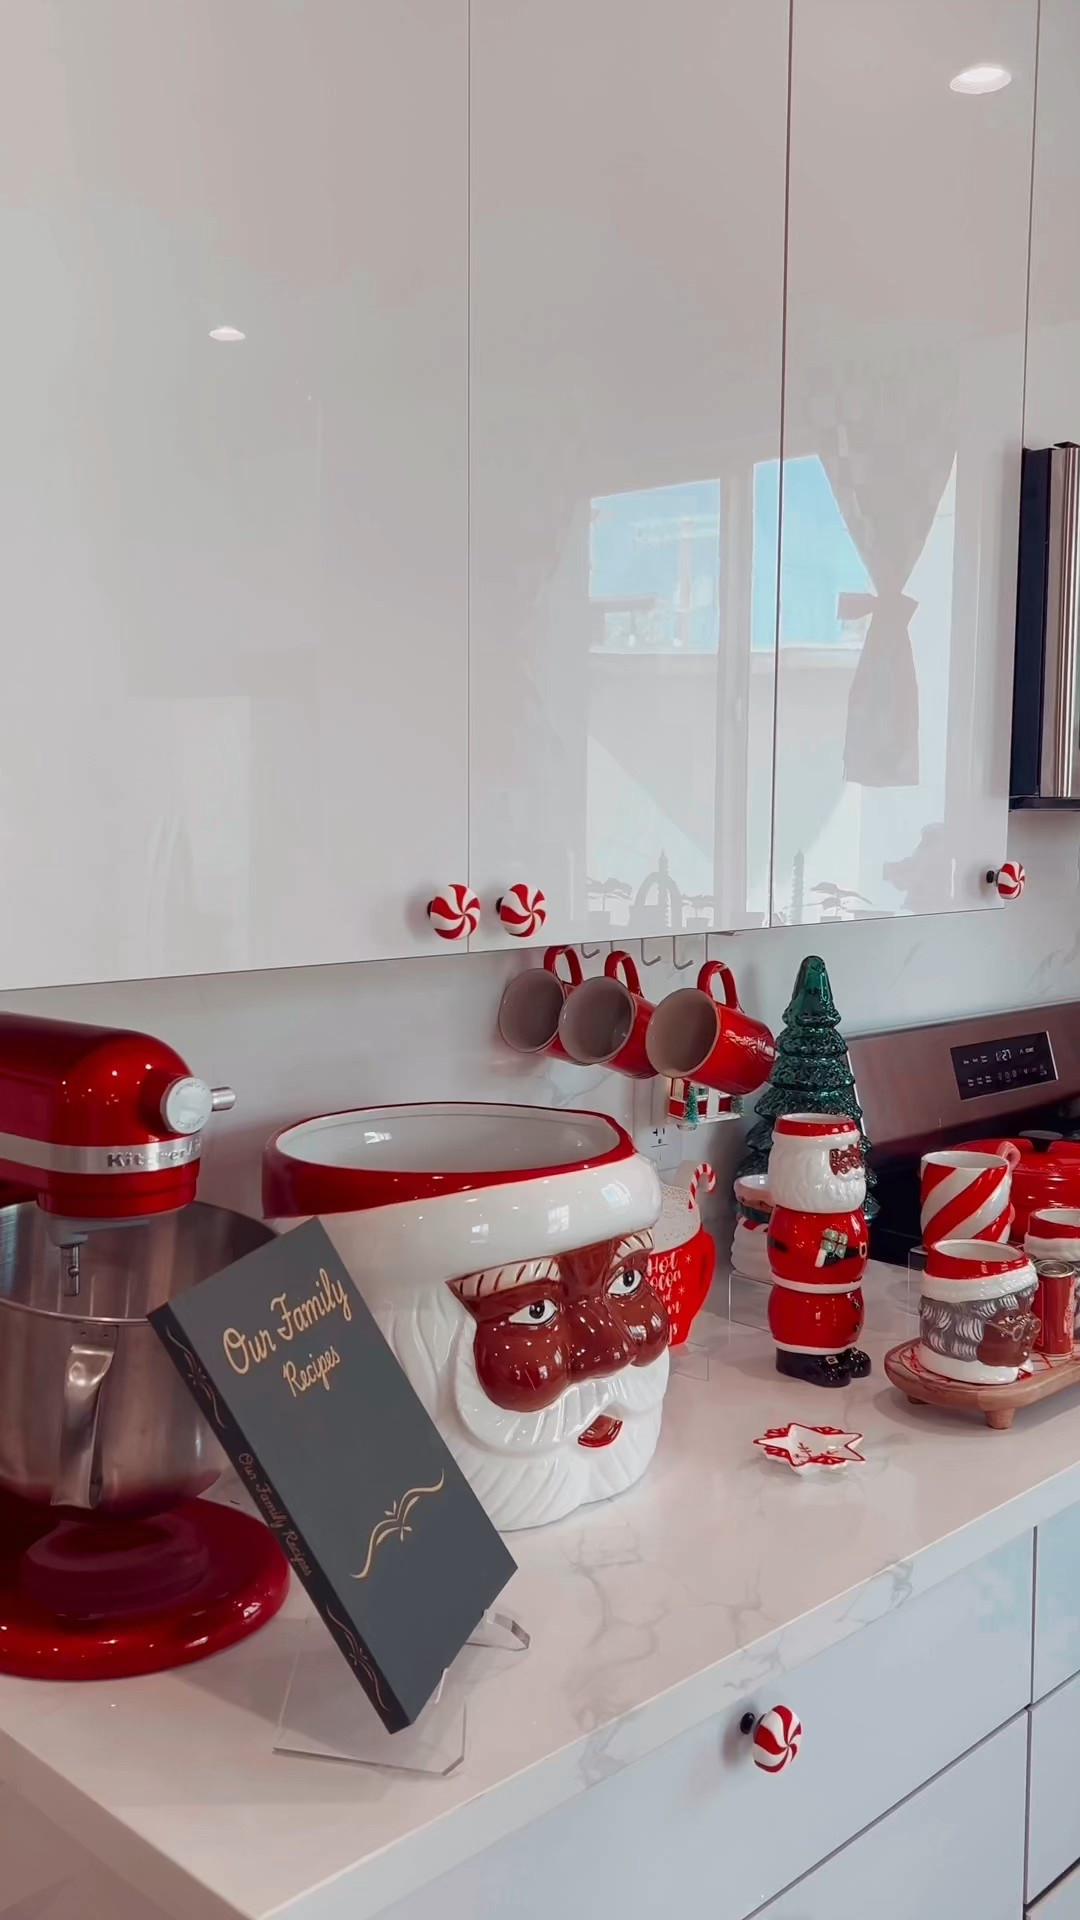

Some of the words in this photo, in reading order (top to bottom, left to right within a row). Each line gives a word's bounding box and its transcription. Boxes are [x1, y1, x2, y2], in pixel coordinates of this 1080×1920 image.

[645, 1269, 682, 1292] ocoa
[646, 1249, 682, 1277] Hot
[223, 1327, 277, 1375] Our
[270, 1267, 352, 1341] Family
[282, 1345, 341, 1398] Recipes
[239, 1452, 257, 1481] Our
[255, 1482, 288, 1529] Family
[282, 1529, 312, 1577] Recipes
